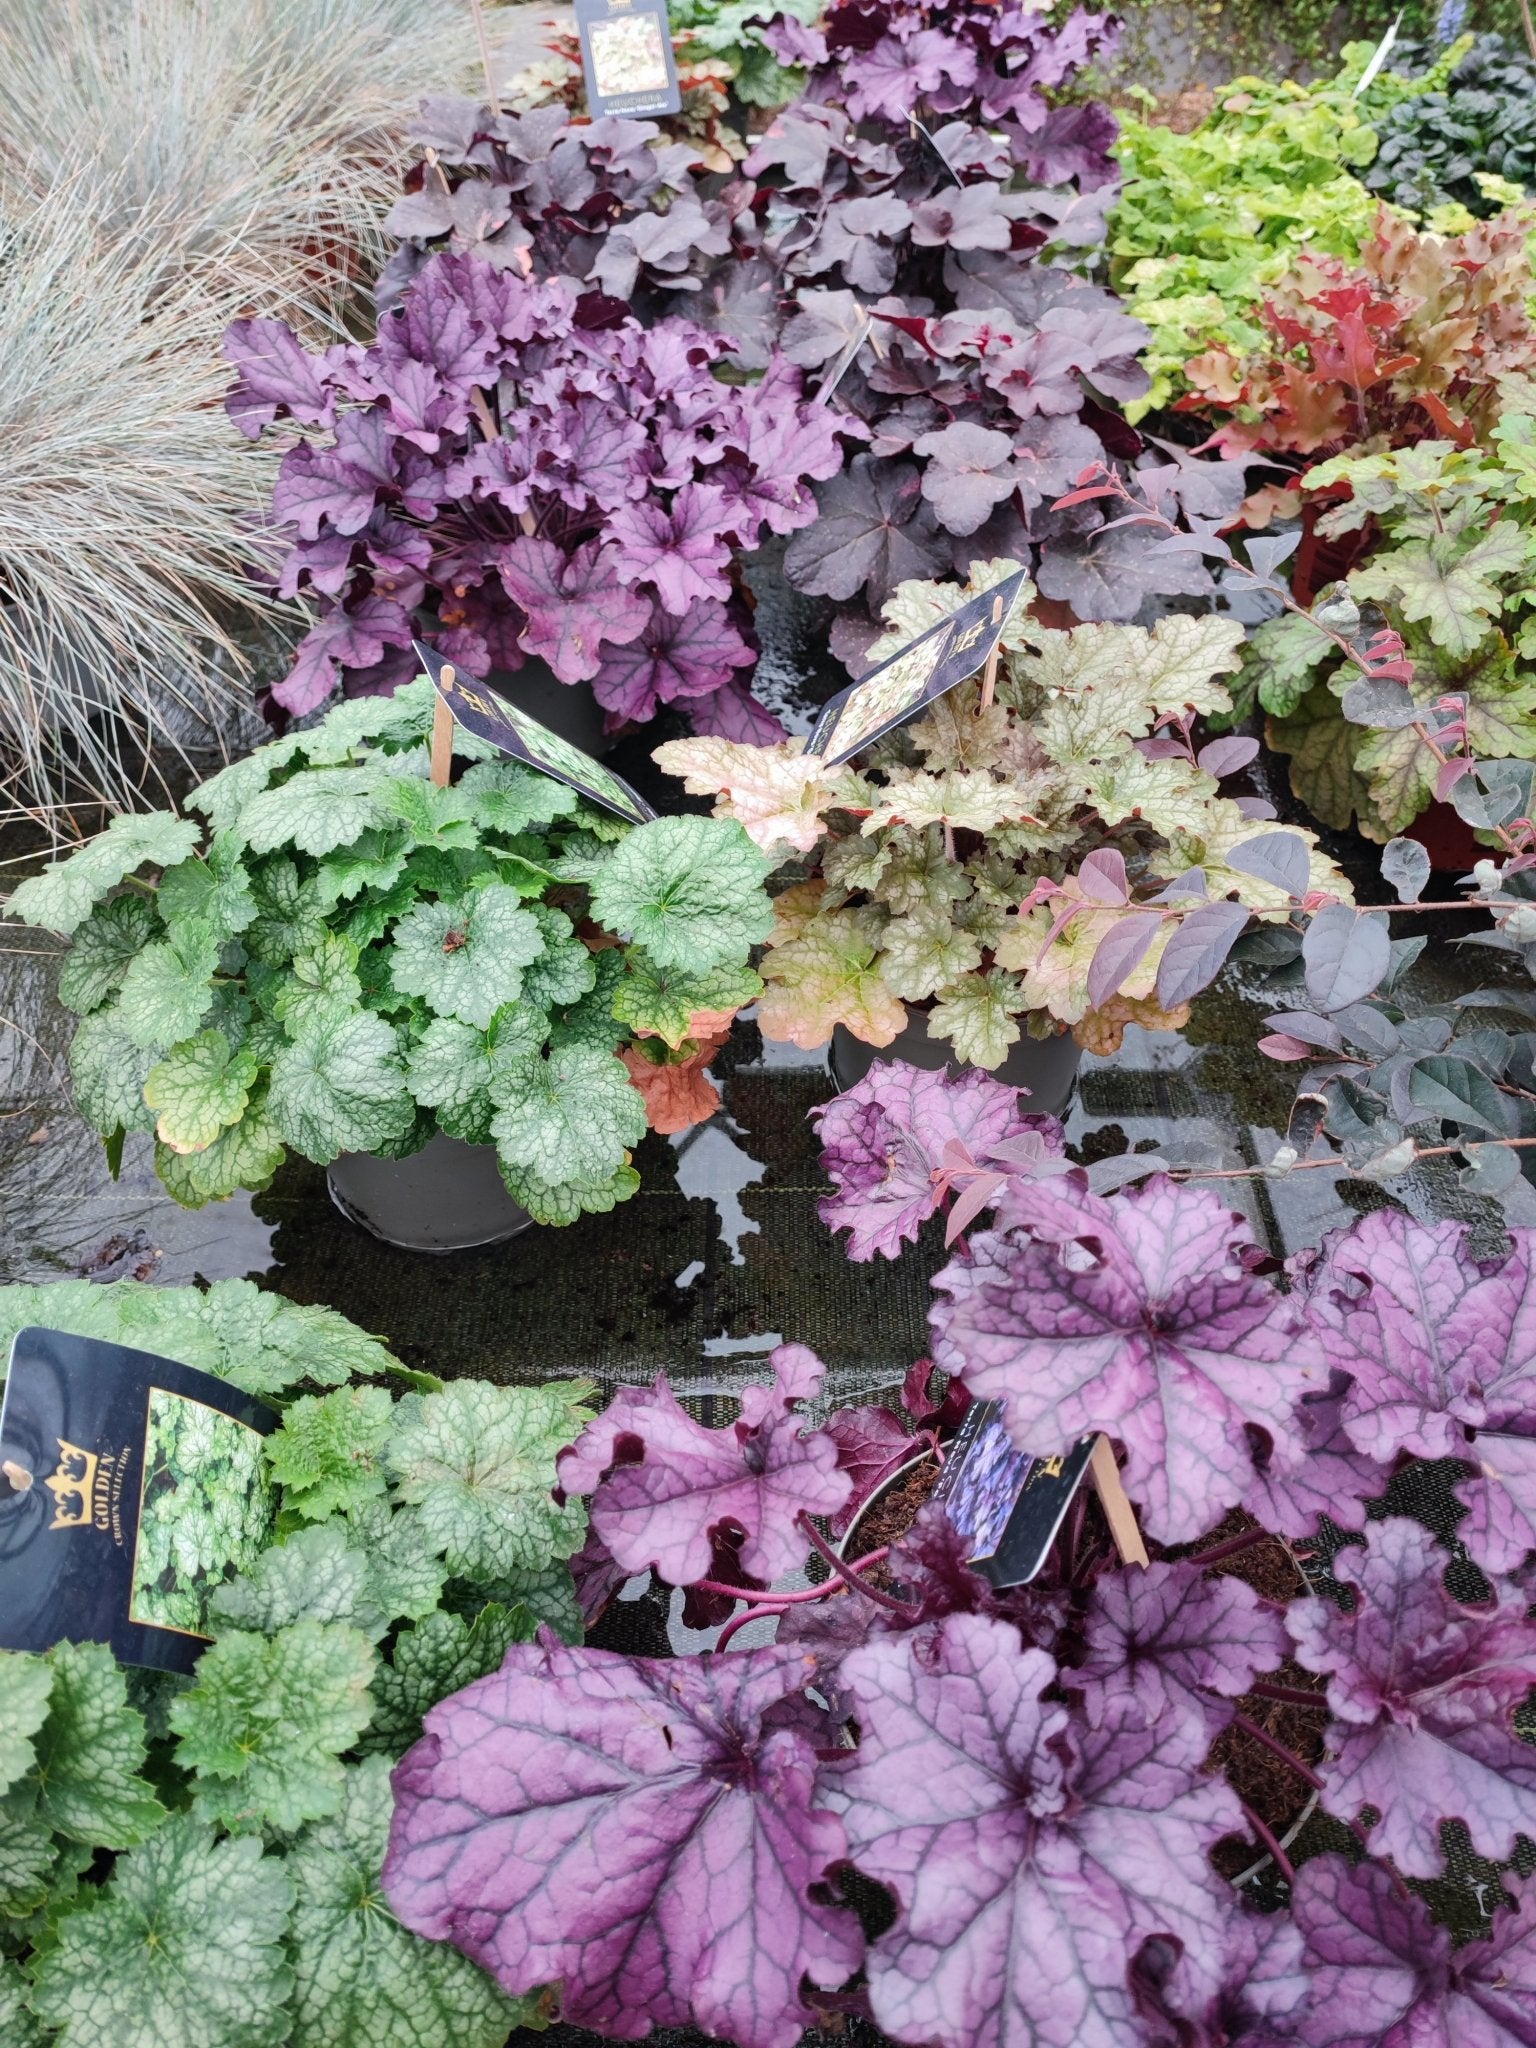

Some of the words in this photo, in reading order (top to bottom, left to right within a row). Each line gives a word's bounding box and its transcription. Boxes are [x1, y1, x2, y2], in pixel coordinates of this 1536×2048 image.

[94, 1452, 116, 1531] GOLDEN
[112, 1445, 132, 1502] SELECTION
[111, 1504, 124, 1547] CROWN
